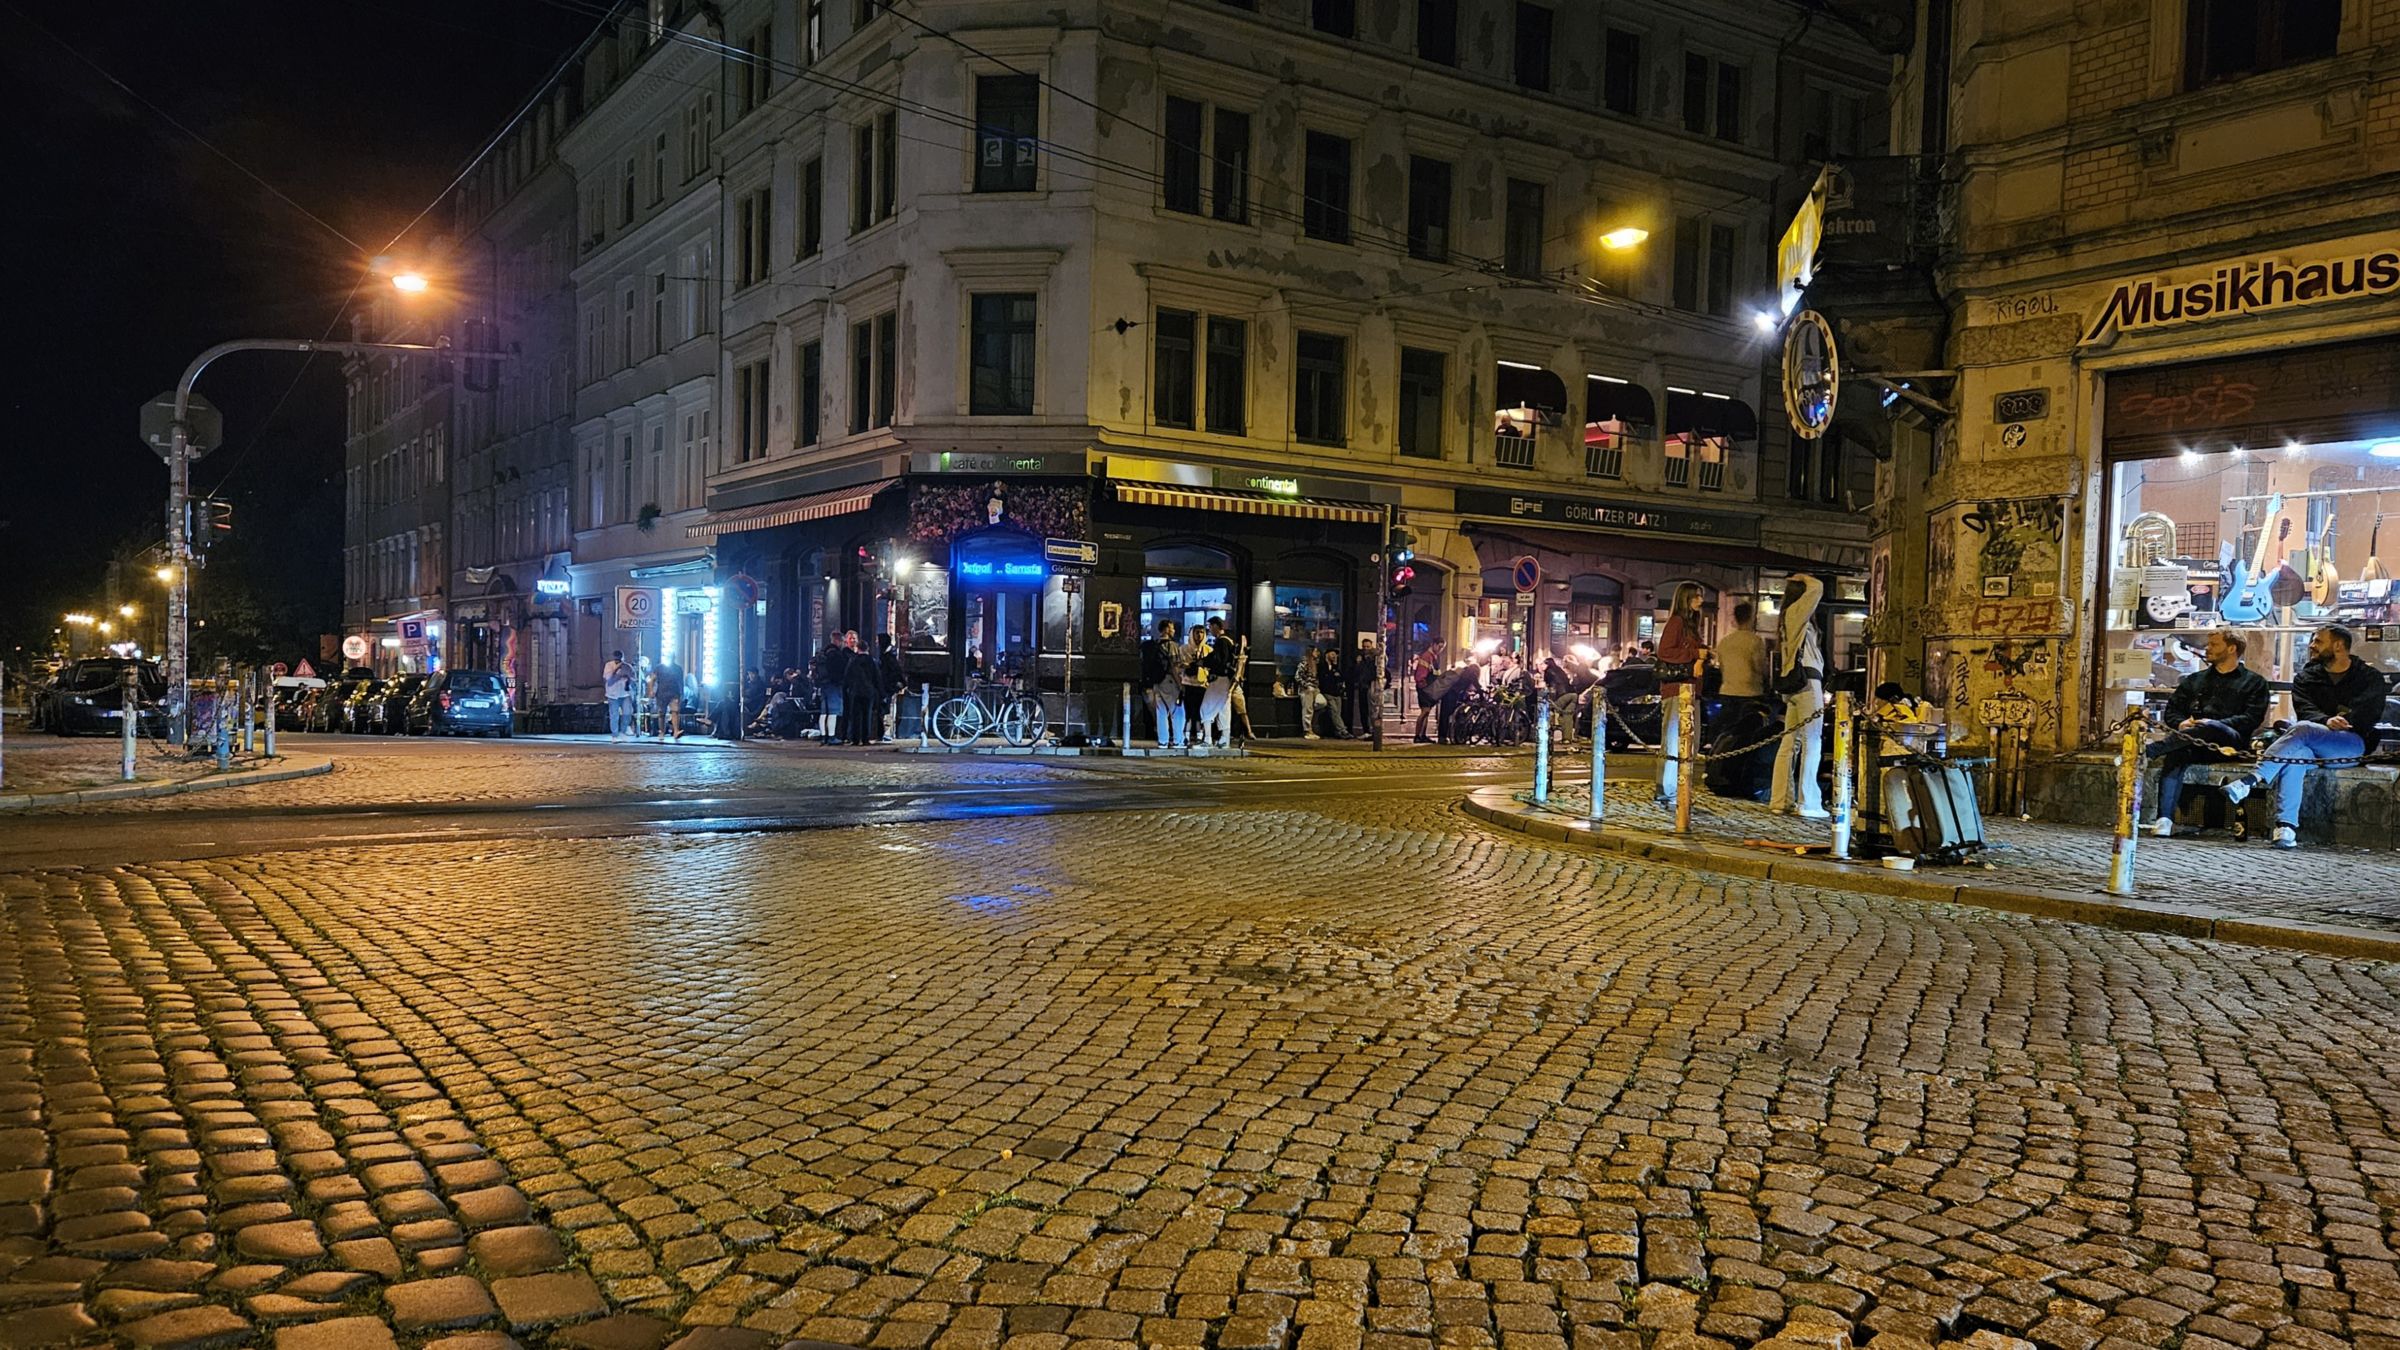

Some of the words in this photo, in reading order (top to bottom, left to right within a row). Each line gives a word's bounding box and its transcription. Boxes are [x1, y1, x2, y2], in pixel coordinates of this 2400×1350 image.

[1823, 216, 1877, 236] skron
[2084, 251, 2400, 340] Musikhaus
[980, 456, 1046, 471] coinental
[1245, 475, 1298, 495] continental
[1565, 504, 1625, 525] GÖRLITZER
[1627, 512, 1661, 527] PLATZ
[1052, 564, 1079, 575] Görlitzer
[631, 598, 648, 611] 20
[628, 618, 650, 626] ZONE
[406, 623, 418, 637] P
